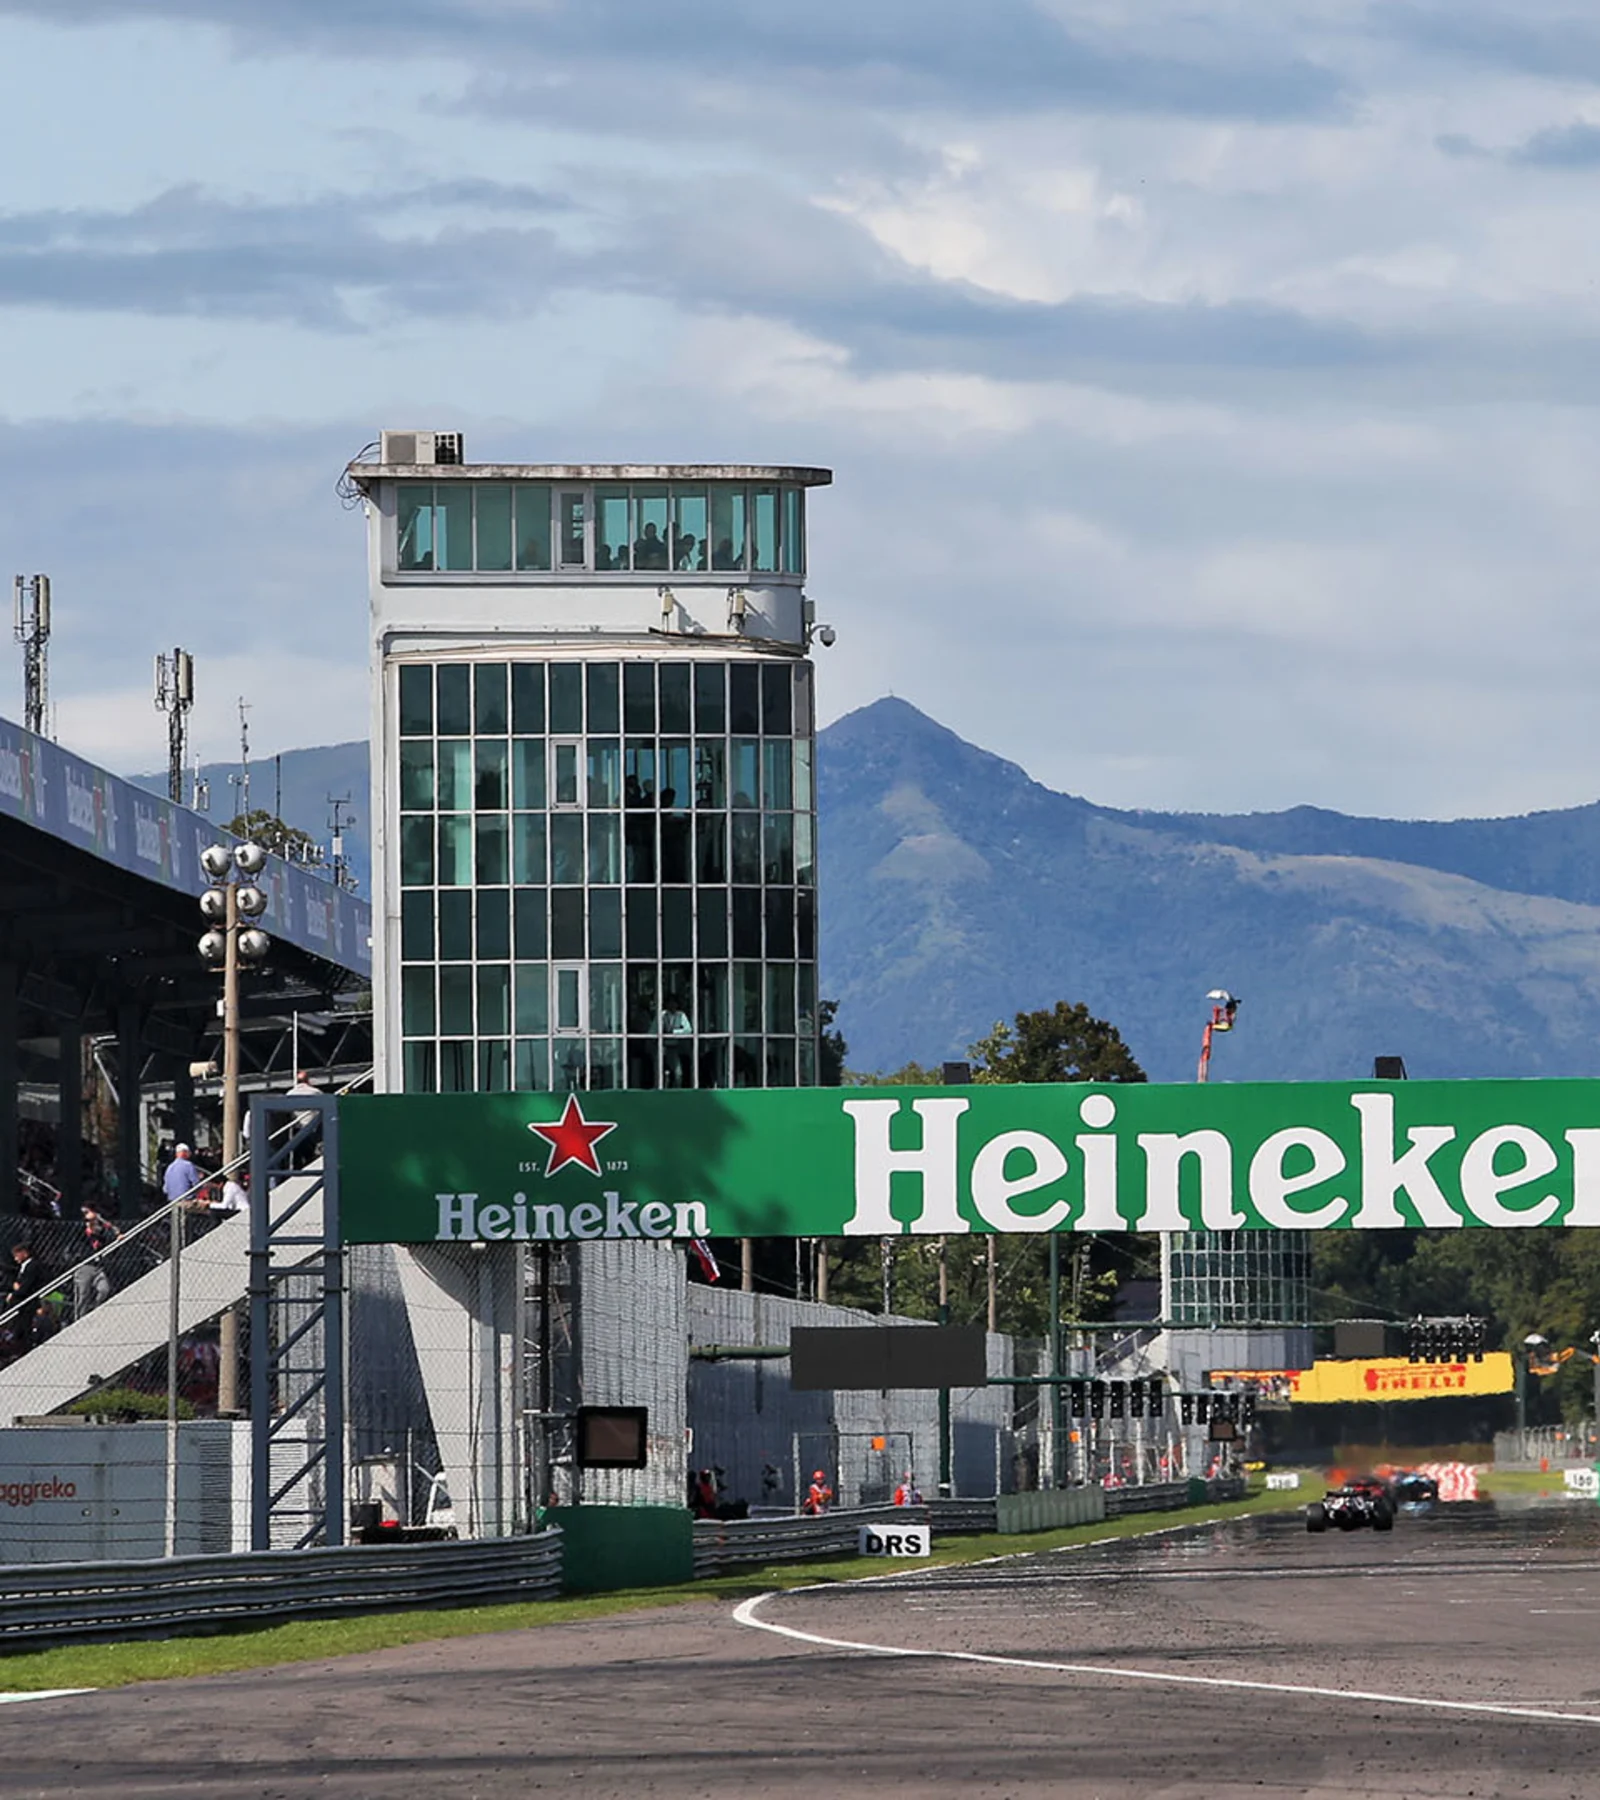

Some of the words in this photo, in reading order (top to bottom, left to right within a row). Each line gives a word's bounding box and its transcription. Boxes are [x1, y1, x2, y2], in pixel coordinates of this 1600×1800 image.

[519, 1161, 541, 1173] EST.
[435, 1191, 711, 1241] Heineken
[0, 1475, 77, 1507] aggreko
[866, 1534, 922, 1554] DRS
